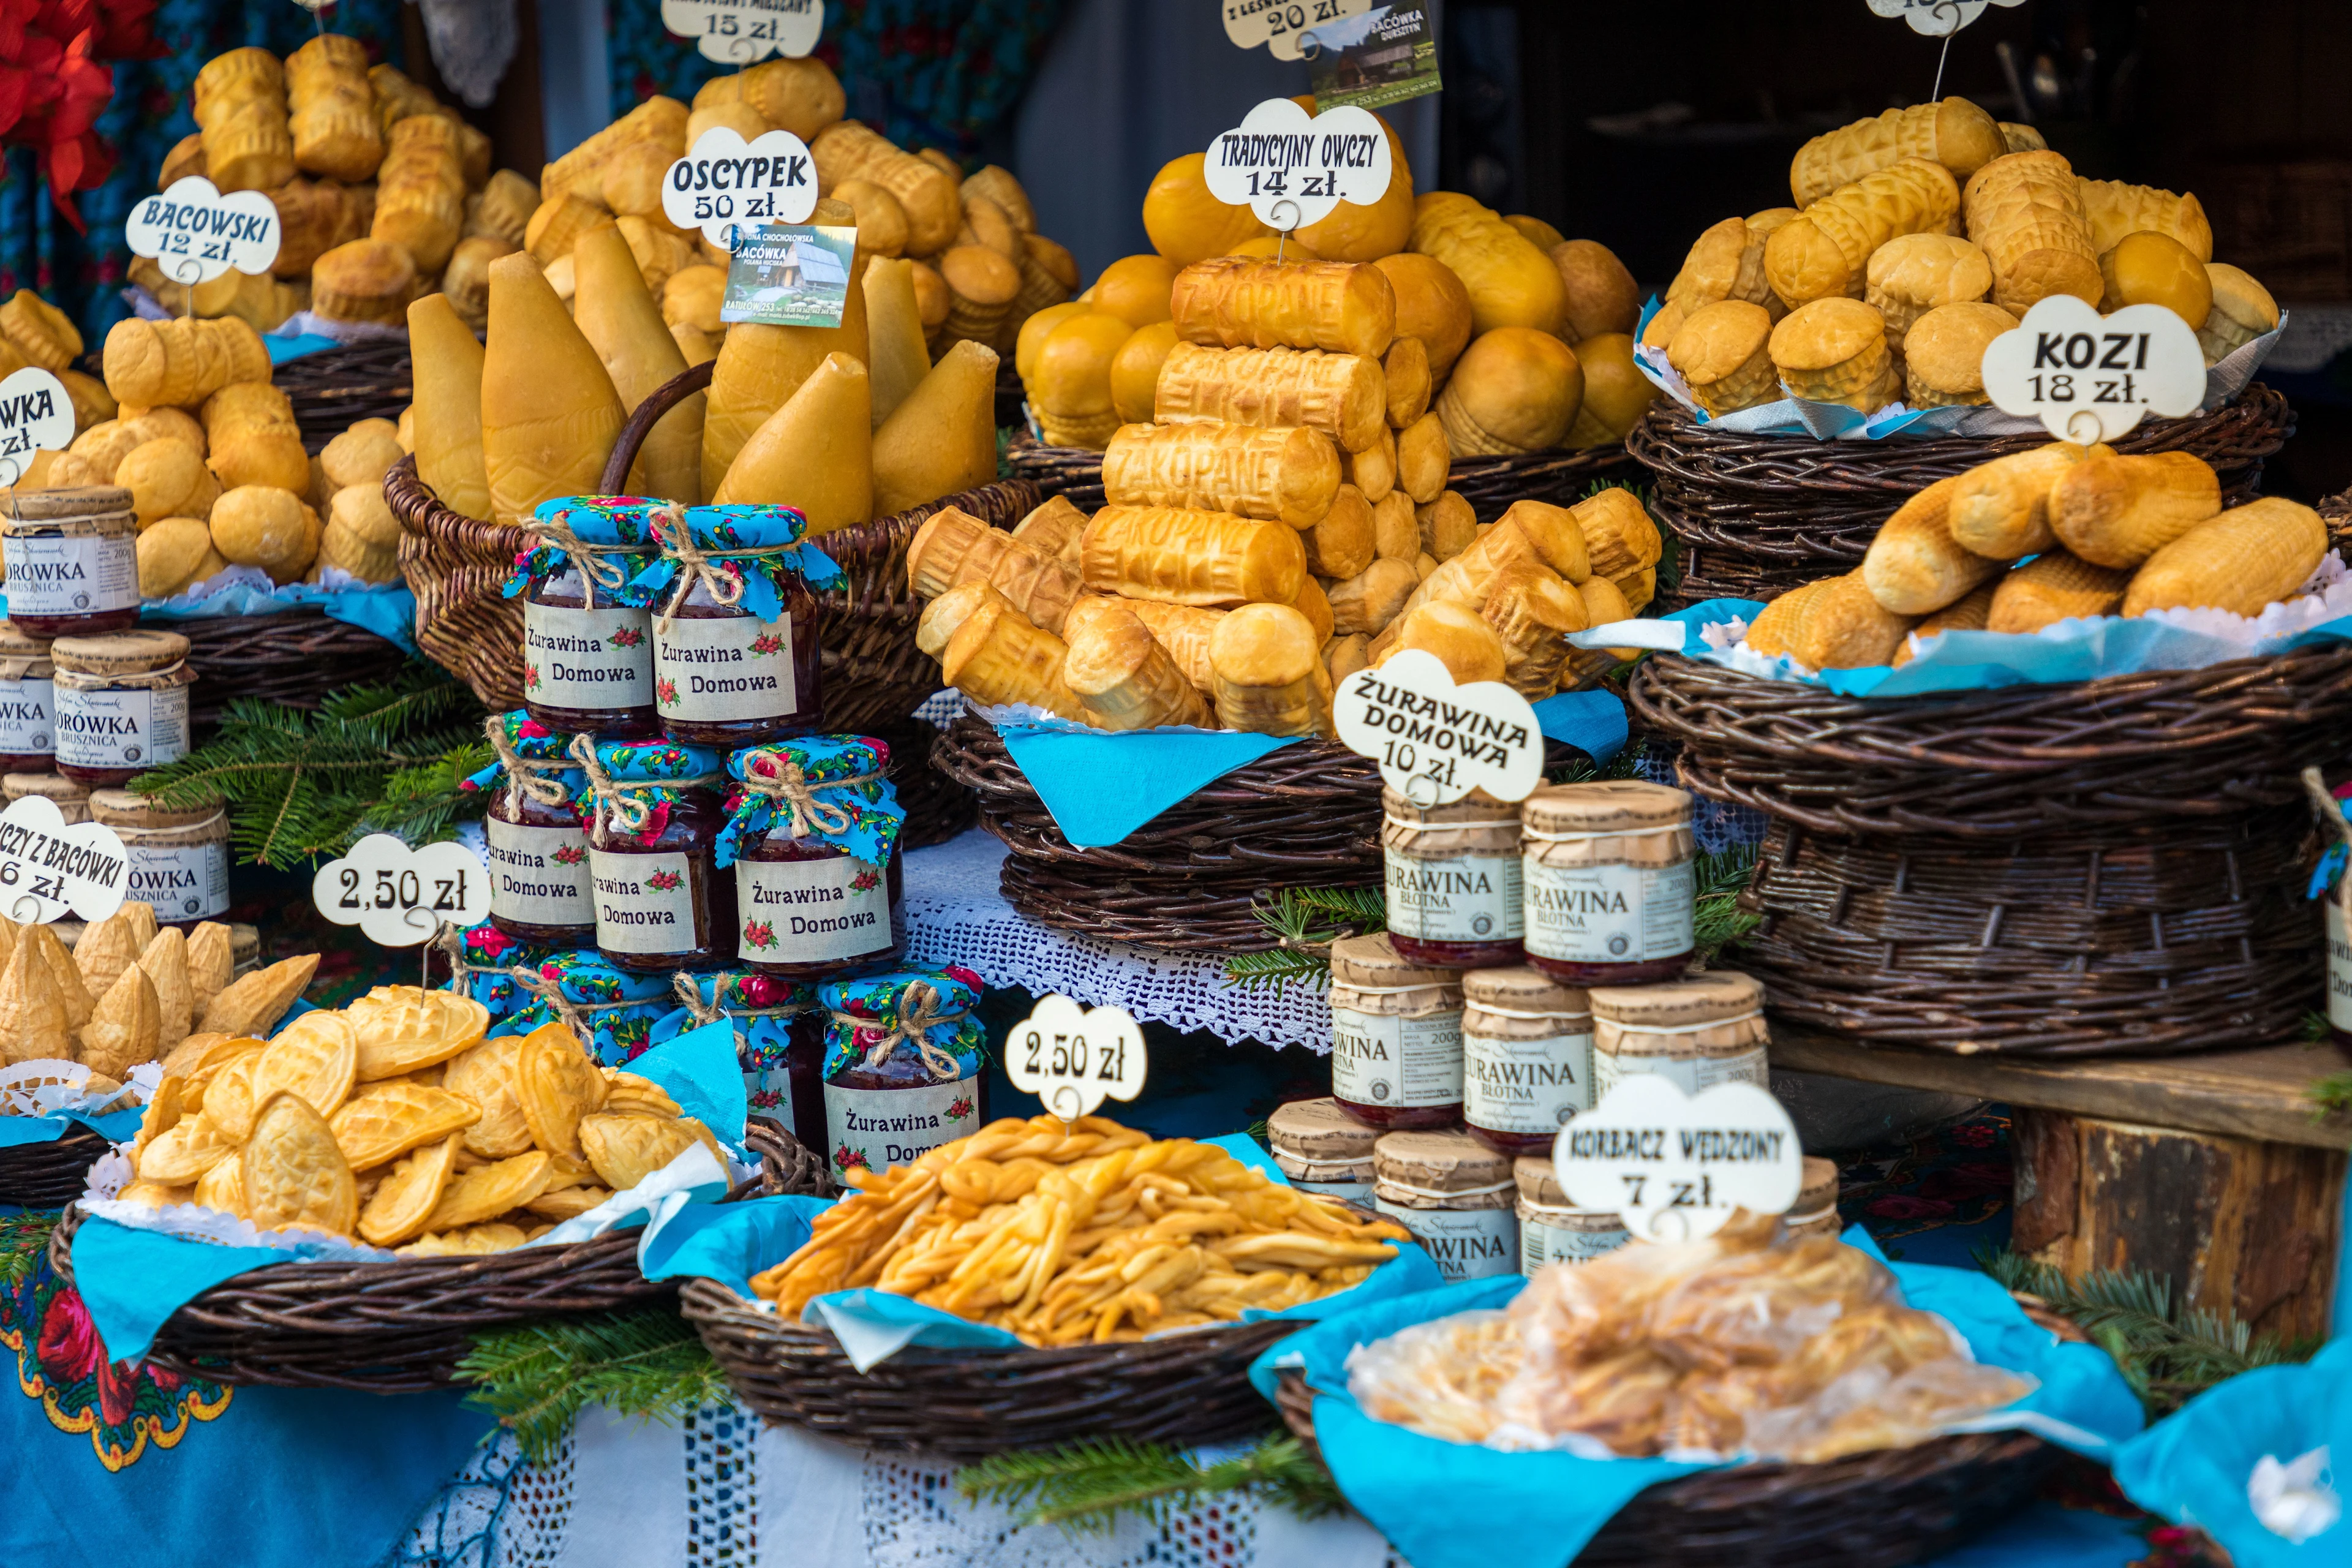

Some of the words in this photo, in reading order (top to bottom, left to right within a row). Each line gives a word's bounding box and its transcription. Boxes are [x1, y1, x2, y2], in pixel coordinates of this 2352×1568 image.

[705, 13, 740, 36] 15
[750, 18, 785, 42] zł.
[1267, 5, 1305, 36] 20
[1370, 9, 1424, 34] BACÓWKA
[1221, 134, 1316, 176] TRADYCYJNY
[1322, 134, 1378, 167] OWCZY
[674, 156, 807, 192] OSCYPEK
[1246, 170, 1287, 196] 14
[1300, 170, 1347, 197] zł.
[694, 195, 733, 219] 50
[745, 192, 783, 217] zł.
[141, 198, 271, 244] BACOWSKI
[158, 231, 191, 255] 12
[200, 239, 238, 264] zł.
[761, 303, 775, 311] 253
[2033, 332, 2151, 369] KOZI
[2027, 374, 2076, 402] 18
[2092, 373, 2149, 403] zł.
[1, 427, 42, 456] zł.
[1115, 445, 1279, 497] ZAKOPANE
[9, 581, 64, 594] BRUSZNICA
[528, 624, 602, 653] Żurawina
[662, 638, 743, 663] Żurawina
[552, 663, 636, 682] Domowa
[691, 676, 777, 694] Domowa
[1354, 671, 1529, 749] ŻURAWINA
[61, 731, 118, 747] BRUSZNICA
[1363, 704, 1509, 769] DOMOWA
[1384, 740, 1416, 772] 10
[1424, 757, 1462, 790] zł.
[0, 821, 35, 858] CZY
[28, 834, 48, 863] Z
[42, 840, 124, 888] BACÓWKI
[0, 861, 21, 886] 6
[28, 875, 69, 905] zł.
[338, 868, 419, 911] 2,50
[433, 869, 467, 911] zł
[502, 874, 578, 897] Domowa
[752, 880, 844, 904] Żurawina
[1400, 890, 1451, 908] BŁOTNA
[603, 904, 676, 925] Domowa
[790, 911, 876, 935] Domowa
[1537, 910, 1586, 927] BŁOTNA
[1431, 1031, 1461, 1045] 200g
[1025, 1031, 1087, 1079] 2,50
[1097, 1036, 1126, 1082] zł
[1481, 1082, 1534, 1100] BŁOTNA
[846, 1107, 940, 1132] Żurawina
[1569, 1128, 1666, 1161] KORBACZ
[1678, 1128, 1784, 1169] WĘDZONY
[1621, 1174, 1647, 1205] 7
[1670, 1174, 1729, 1208] zł.
